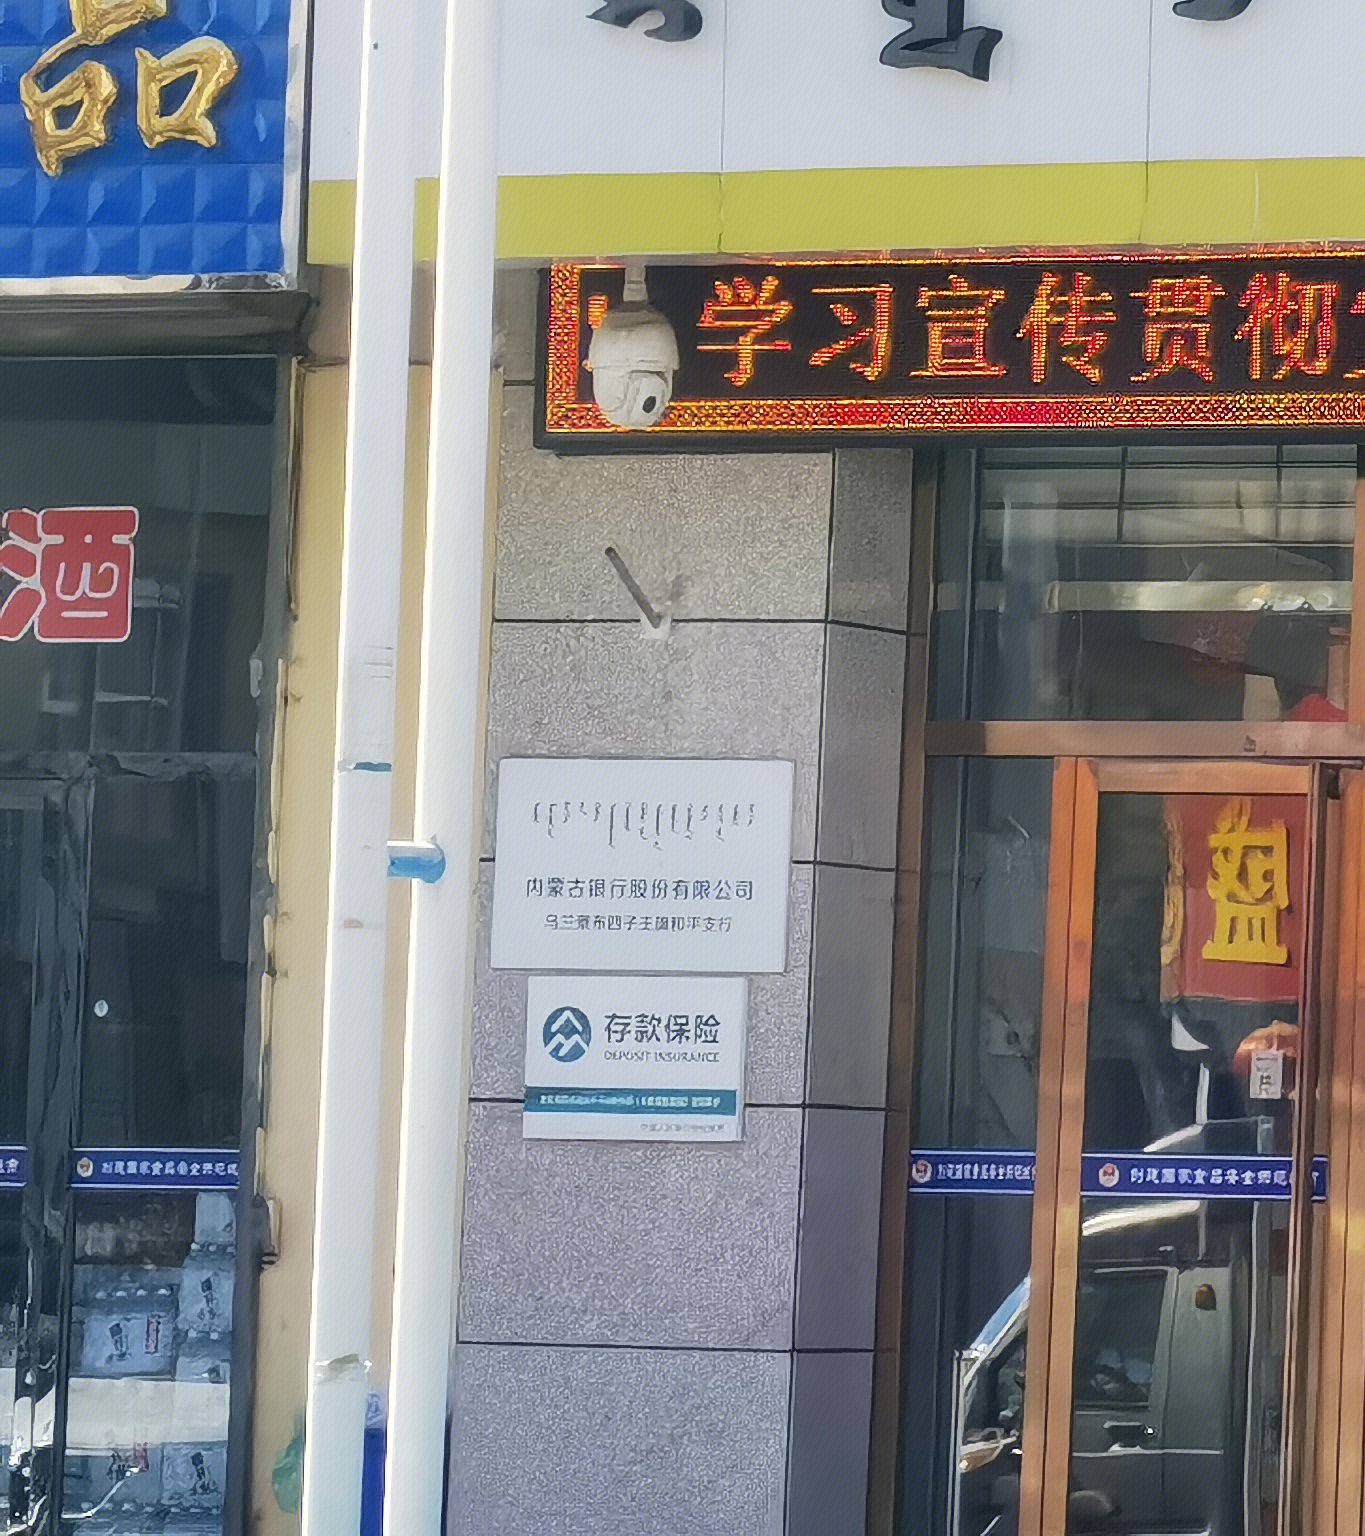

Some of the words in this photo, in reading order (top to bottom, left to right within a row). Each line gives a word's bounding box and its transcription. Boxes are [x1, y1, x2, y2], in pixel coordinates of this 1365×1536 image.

[0, 506, 139, 643] 酒
[525, 876, 754, 901] 内蒙古银行股份有限公司
[603, 1013, 721, 1045] 存款保险
[603, 1050, 652, 1062] DEPOSIT
[654, 1050, 721, 1063] INSURANCE
